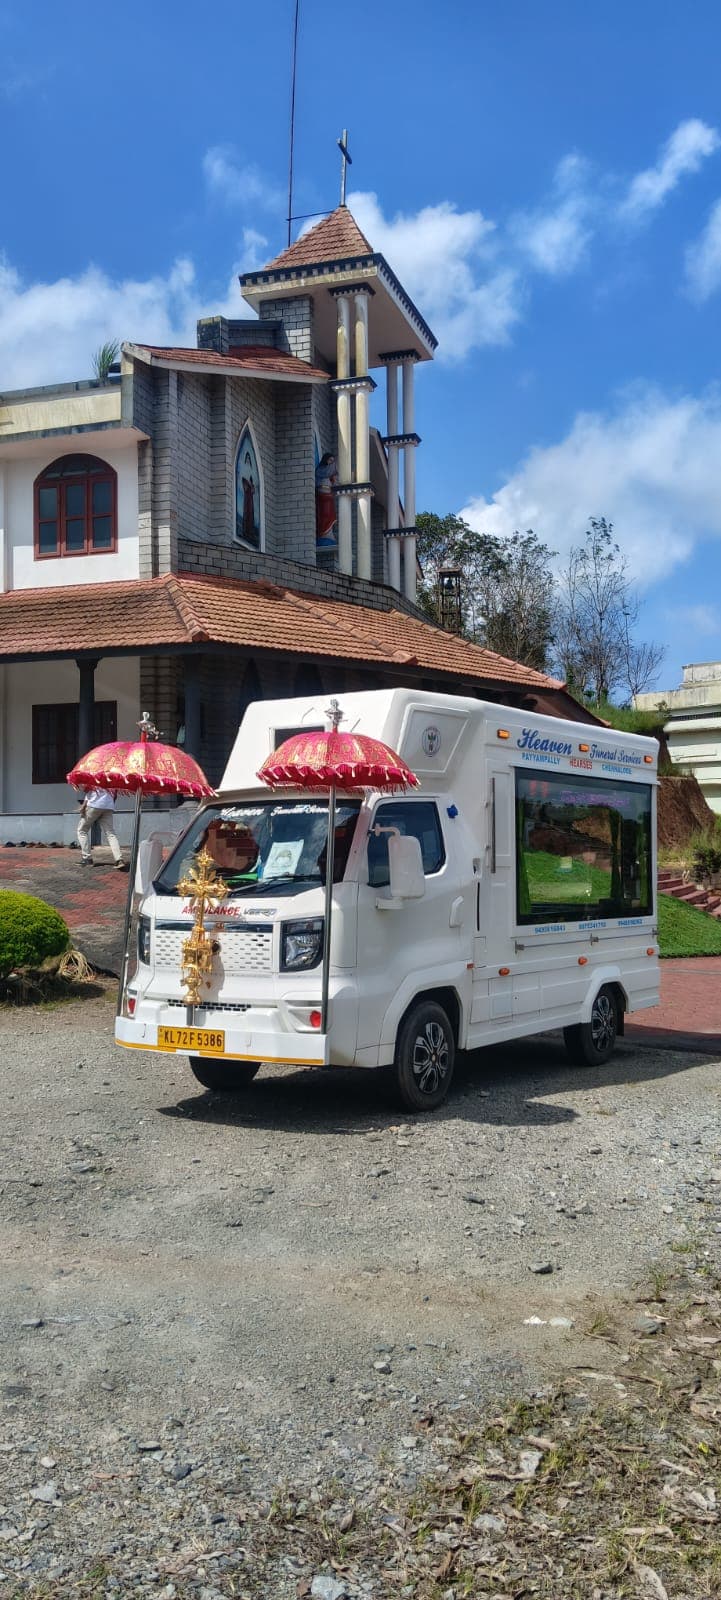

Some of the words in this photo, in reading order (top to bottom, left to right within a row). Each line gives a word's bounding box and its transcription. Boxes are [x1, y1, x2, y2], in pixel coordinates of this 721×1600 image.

[517, 728, 572, 755] Heaven
[590, 744, 618, 761] Funeral
[618, 750, 641, 765] Services
[522, 753, 560, 765] PAYYAMPALLY
[569, 758, 593, 769] HEARSES
[181, 905, 241, 916] AMULANCE
